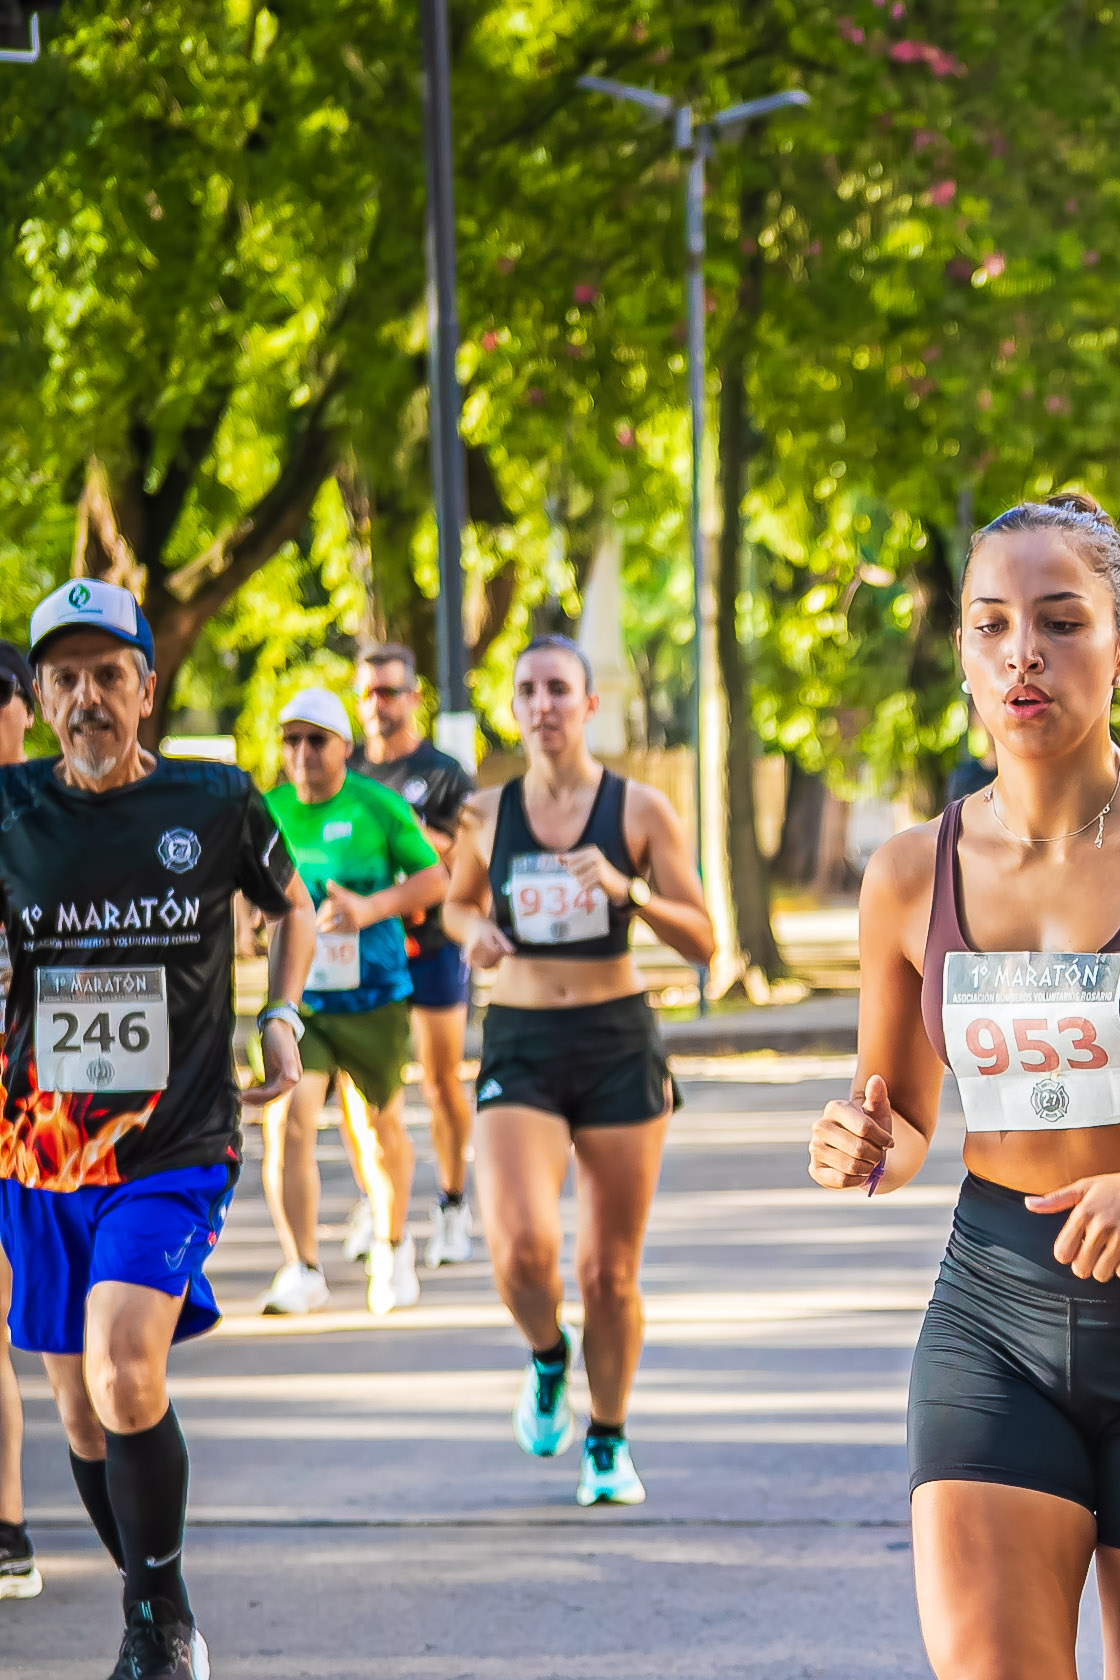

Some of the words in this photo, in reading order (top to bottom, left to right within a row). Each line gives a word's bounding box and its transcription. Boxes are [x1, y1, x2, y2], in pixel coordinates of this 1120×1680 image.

[57, 886, 200, 932] MARATÓN
[519, 885, 596, 916] 934
[70, 972, 147, 994] MARATÓN
[994, 957, 1099, 988] MARATÓN
[1080, 991, 1112, 1001] ROSARIO
[52, 1010, 150, 1053] 246
[965, 1016, 1109, 1076] 953
